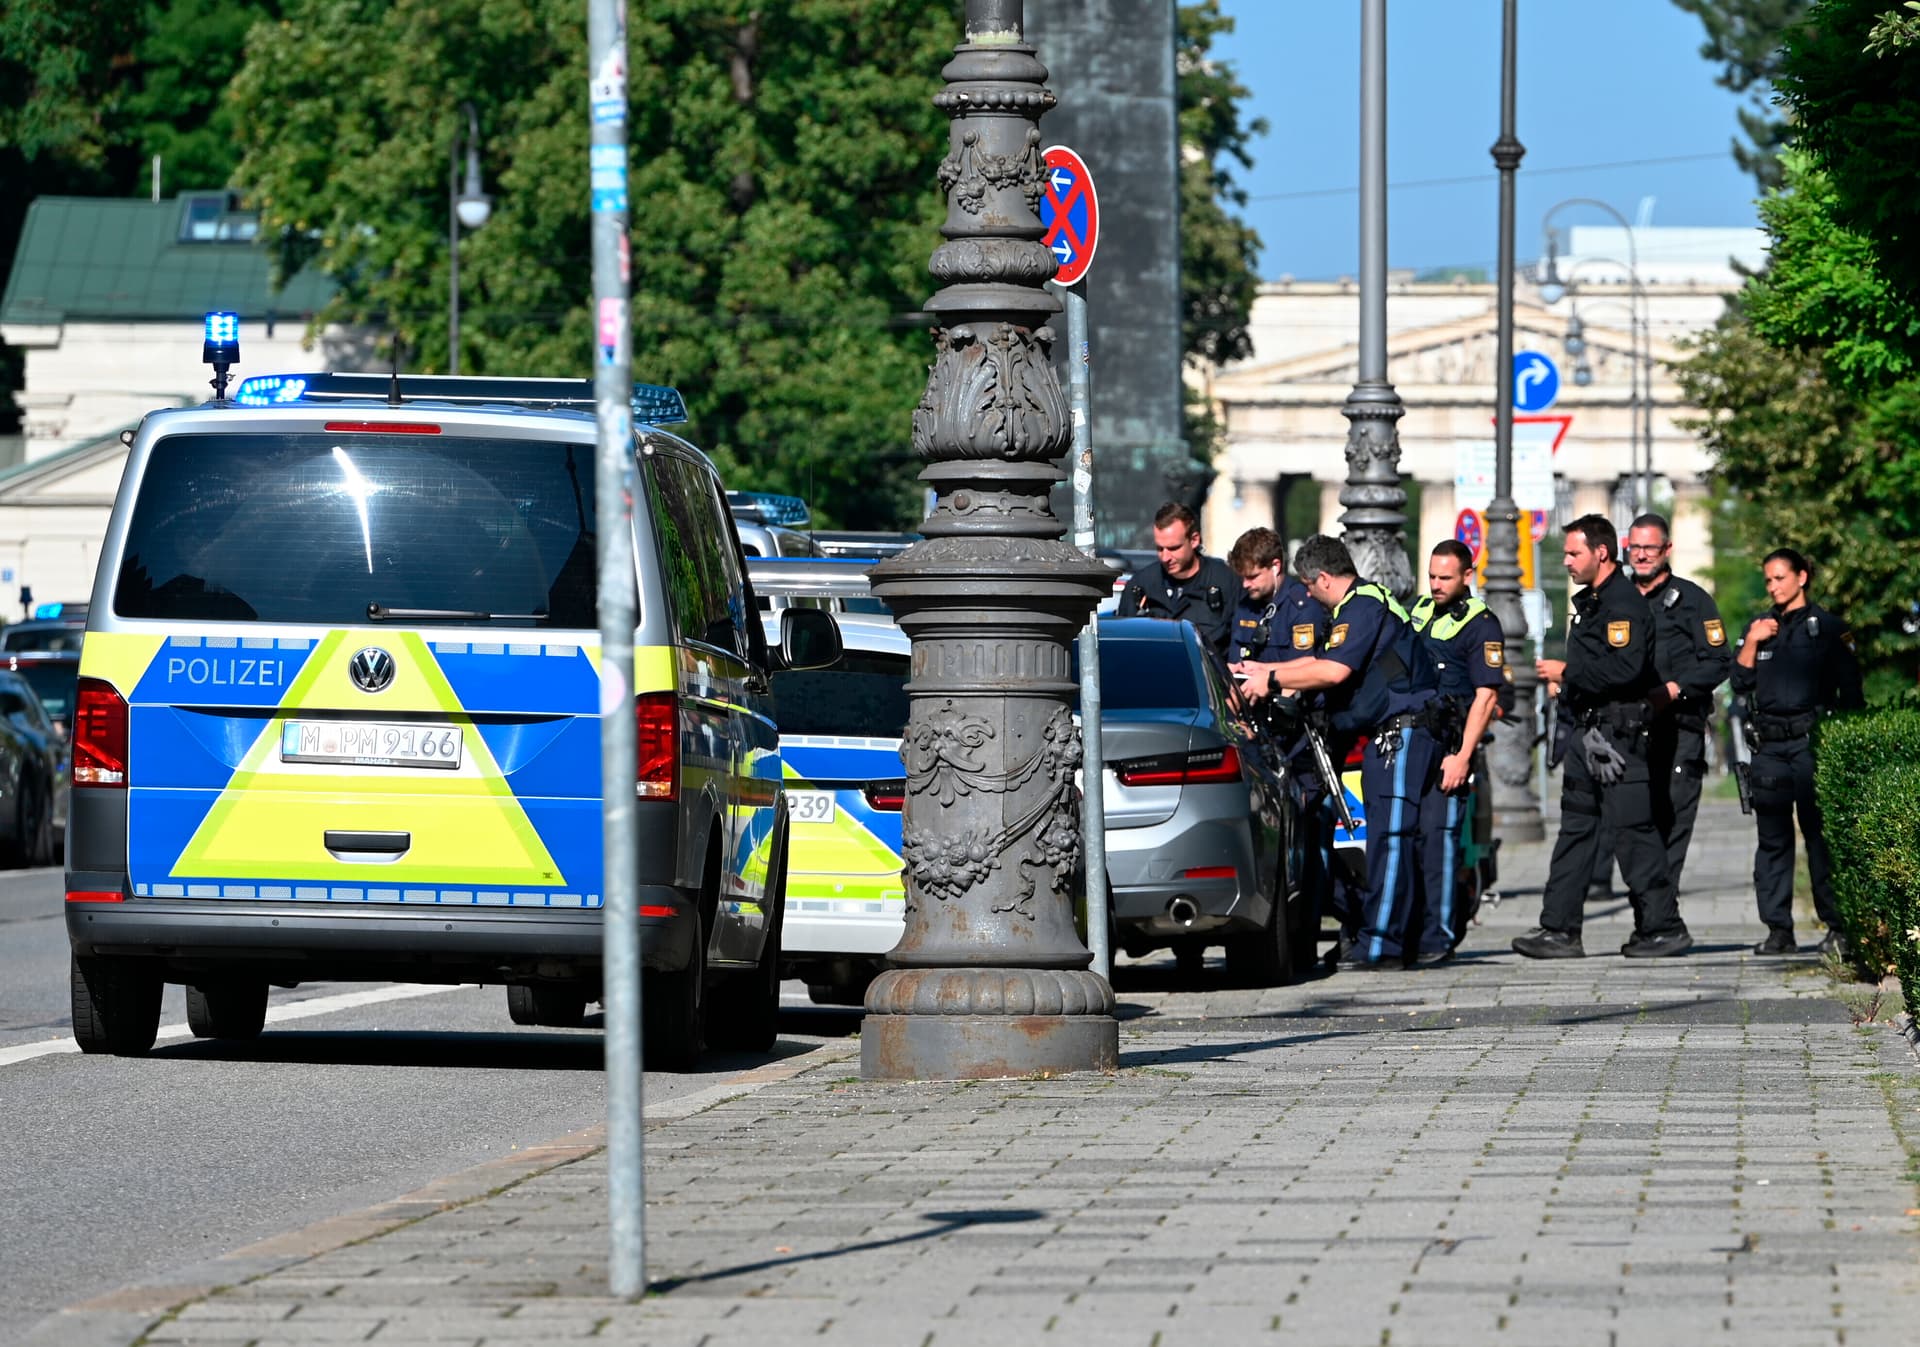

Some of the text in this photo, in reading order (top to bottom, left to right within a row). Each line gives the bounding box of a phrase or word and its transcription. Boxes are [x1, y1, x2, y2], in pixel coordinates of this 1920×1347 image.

[168, 658, 283, 686] POLIZEI
[301, 725, 456, 757] M PM 9166
